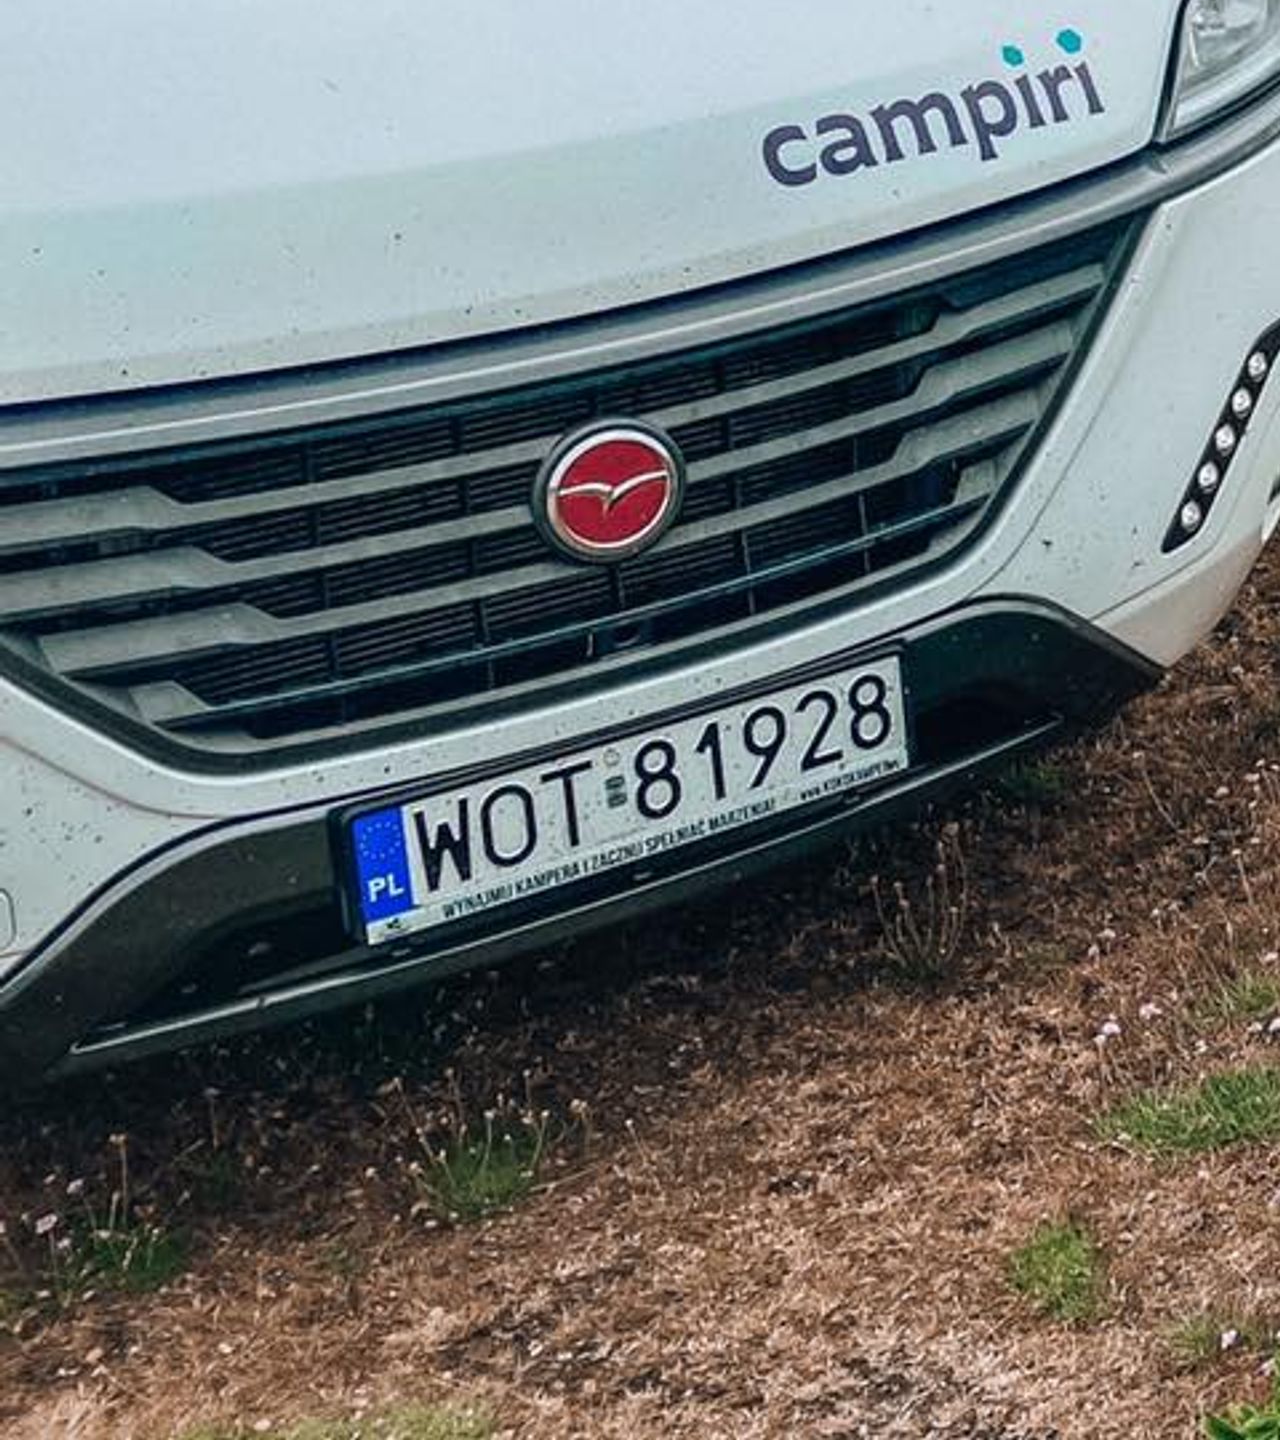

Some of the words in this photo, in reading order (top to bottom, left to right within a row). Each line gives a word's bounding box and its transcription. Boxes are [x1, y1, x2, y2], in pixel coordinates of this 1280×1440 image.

[762, 29, 1105, 186] campiri
[413, 760, 593, 893] WOT
[633, 675, 892, 819] 81928
[368, 872, 404, 902] PL
